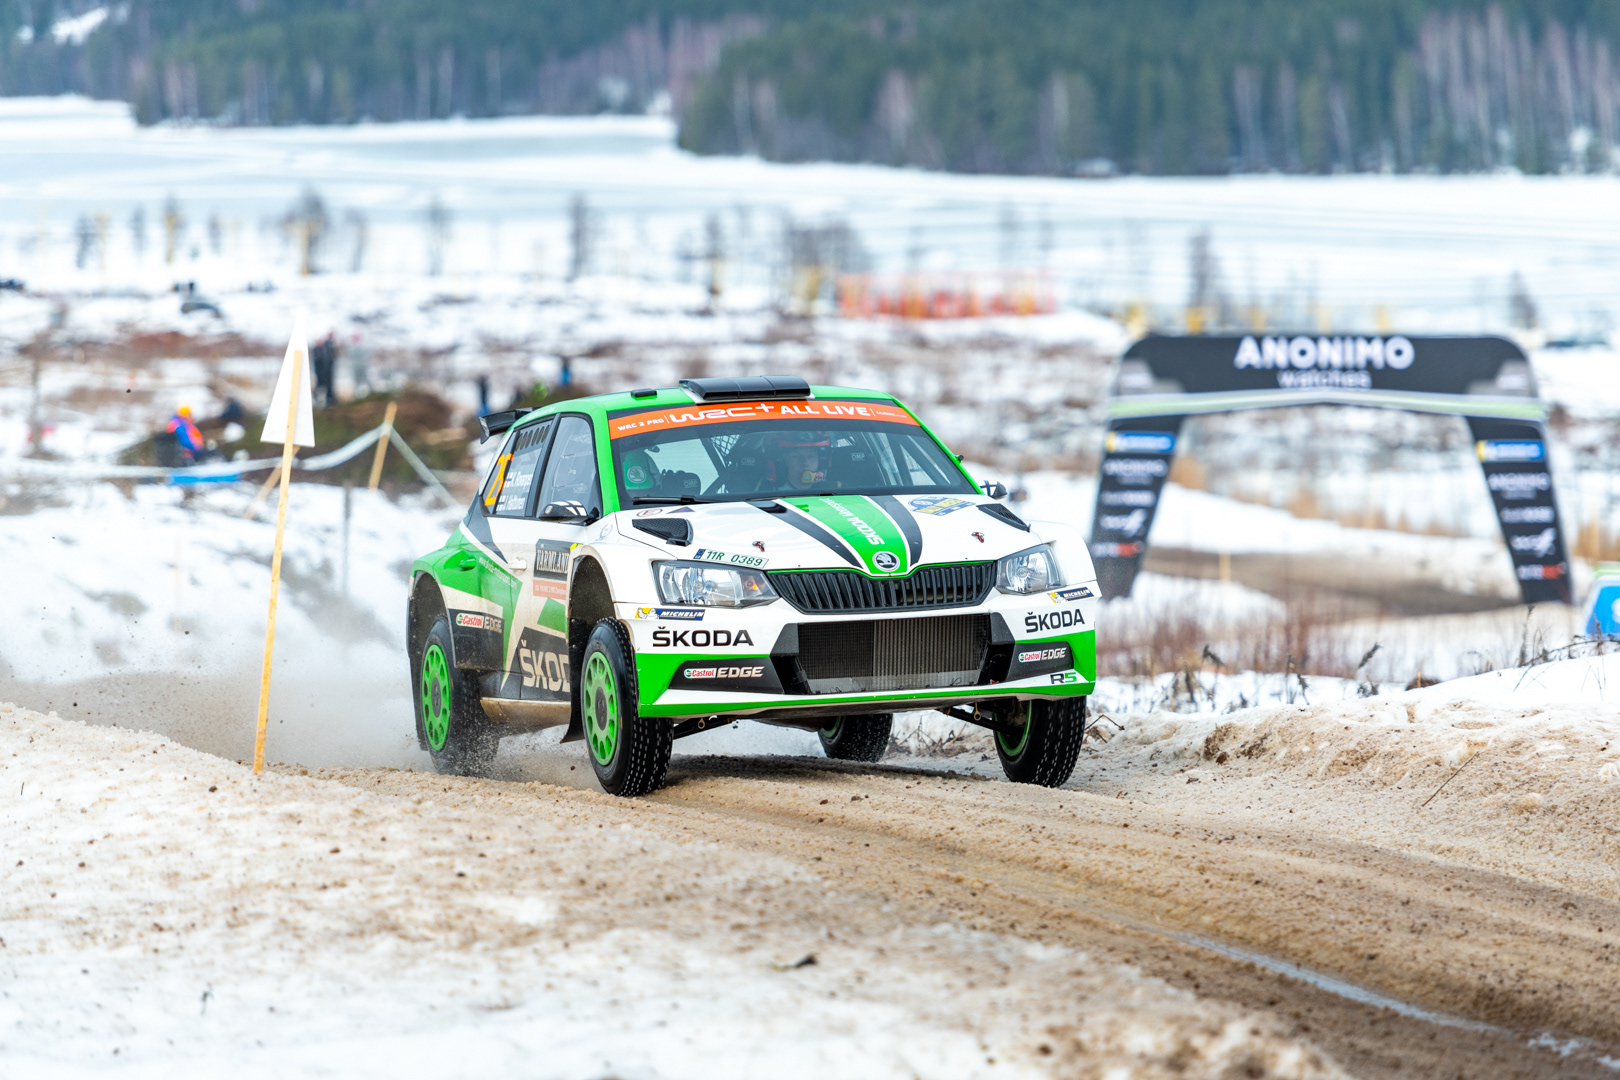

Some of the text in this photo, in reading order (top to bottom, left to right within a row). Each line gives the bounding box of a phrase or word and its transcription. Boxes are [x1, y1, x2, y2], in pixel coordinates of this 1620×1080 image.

[1233, 336, 1415, 370] ANONIMO
[780, 405, 820, 415] ALL
[822, 405, 871, 416] LIVE
[617, 422, 637, 431] WRC
[707, 550, 725, 561] 11R
[730, 555, 763, 567] 0389
[660, 610, 705, 618] MICHELIN
[1024, 608, 1085, 633] ŠKODA
[462, 615, 502, 633] Castrol EDGE
[652, 626, 754, 647] ŠKODA
[1024, 647, 1067, 661] Castrol EDGE
[519, 639, 571, 692] ŠKOD
[691, 666, 765, 678] Castrol EDGE
[1050, 672, 1077, 684] R5
